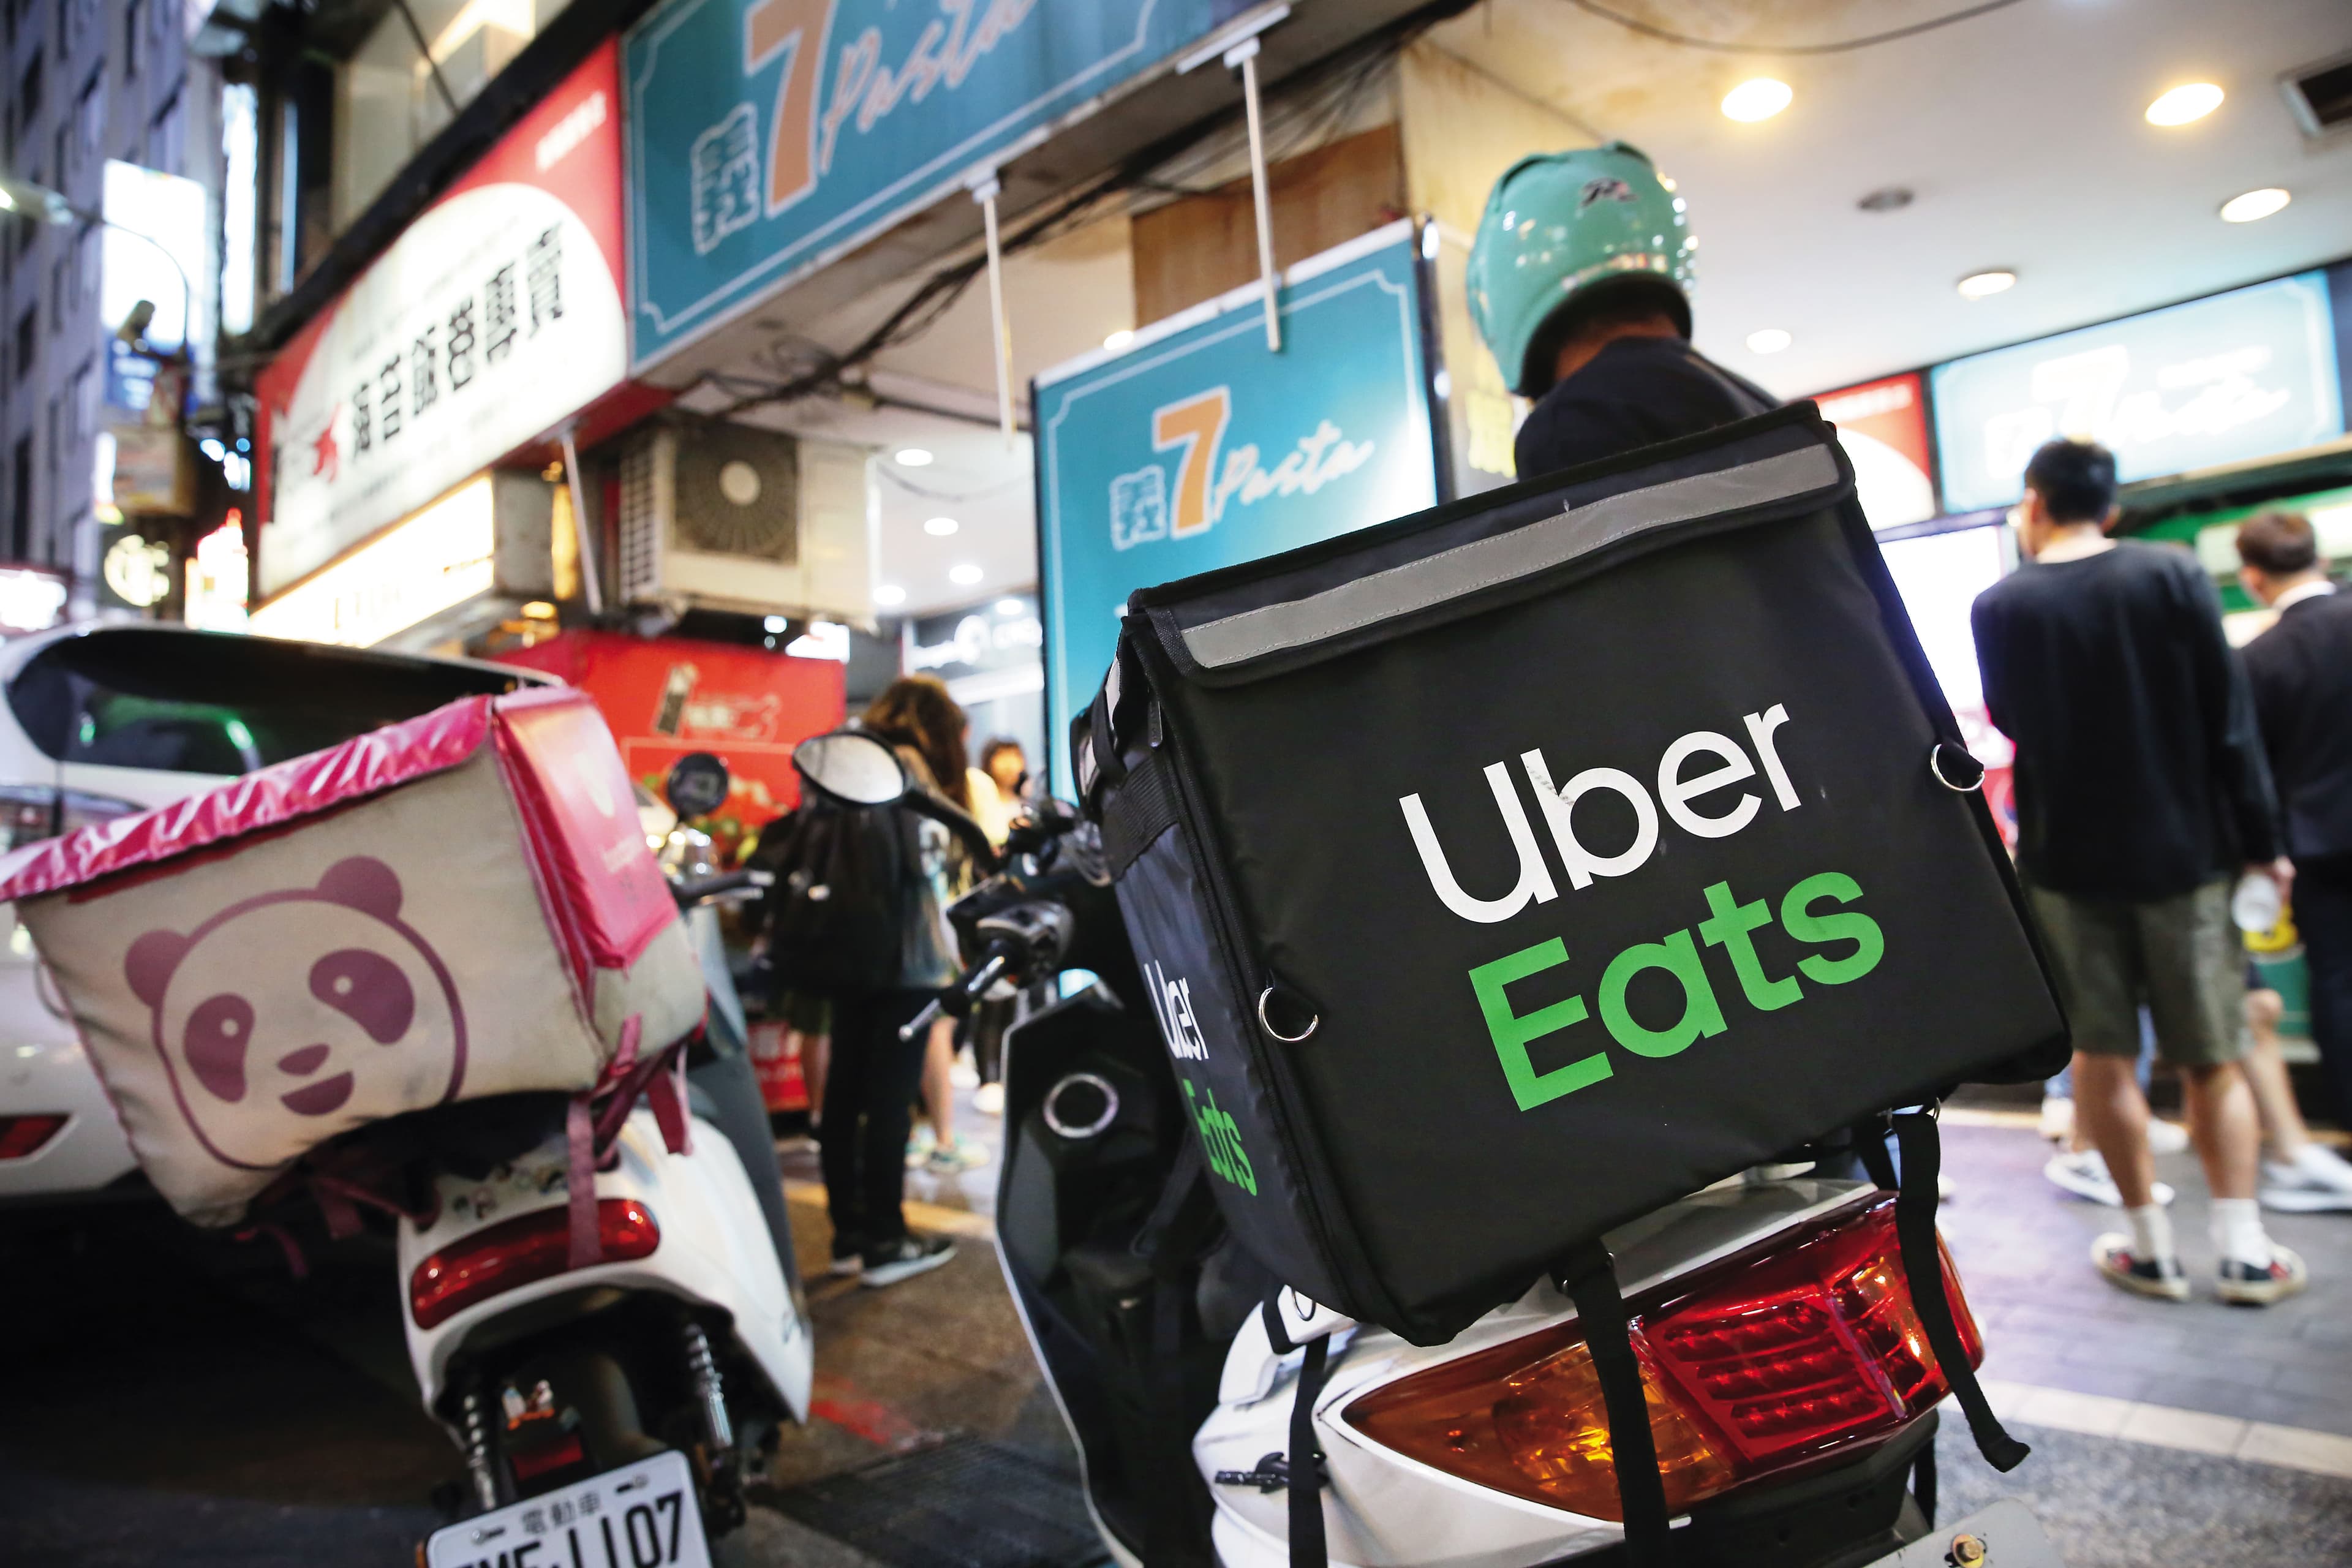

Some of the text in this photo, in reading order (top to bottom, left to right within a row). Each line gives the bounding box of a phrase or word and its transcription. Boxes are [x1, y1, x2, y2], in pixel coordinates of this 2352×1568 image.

[744, 0, 838, 219] 7
[1152, 385, 1233, 540] 7
[1212, 420, 1376, 524] Pasta
[1398, 703, 1802, 924] Uber
[1468, 872, 1885, 1112] Eats
[454, 1490, 683, 1568] 1107
[521, 1490, 601, 1535] 電動車
